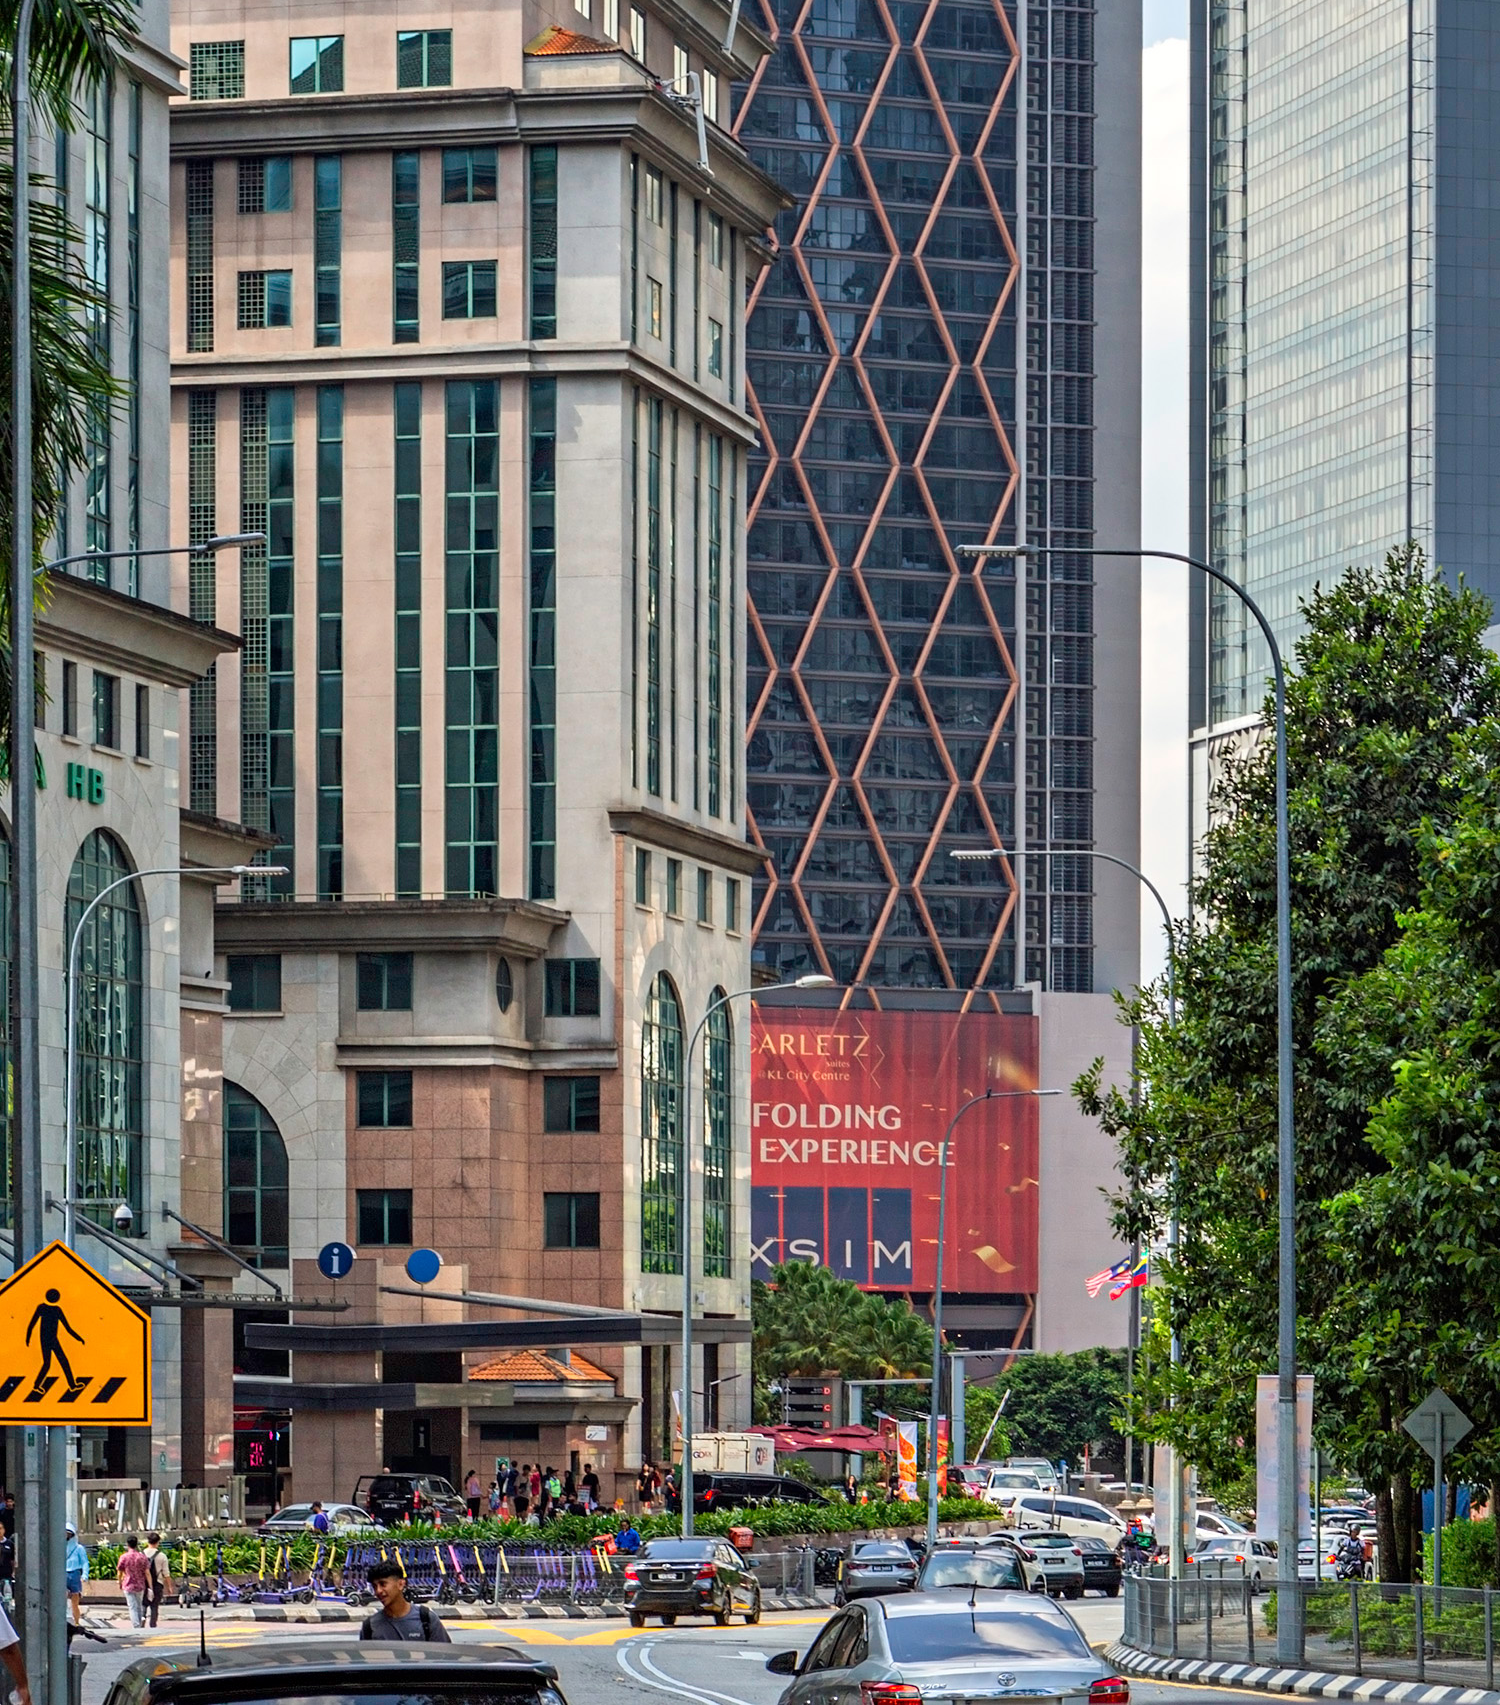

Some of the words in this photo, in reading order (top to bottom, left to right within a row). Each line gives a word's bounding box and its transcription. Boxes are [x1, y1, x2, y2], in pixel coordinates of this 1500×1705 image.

[67, 762, 105, 805] HB
[786, 1070, 810, 1082] City
[812, 1070, 850, 1081] Centre
[826, 1060, 850, 1068] suites
[753, 1103, 901, 1130] FOLDING
[760, 1139, 955, 1166] EXPERIENCE
[750, 1239, 911, 1269] XSIM
